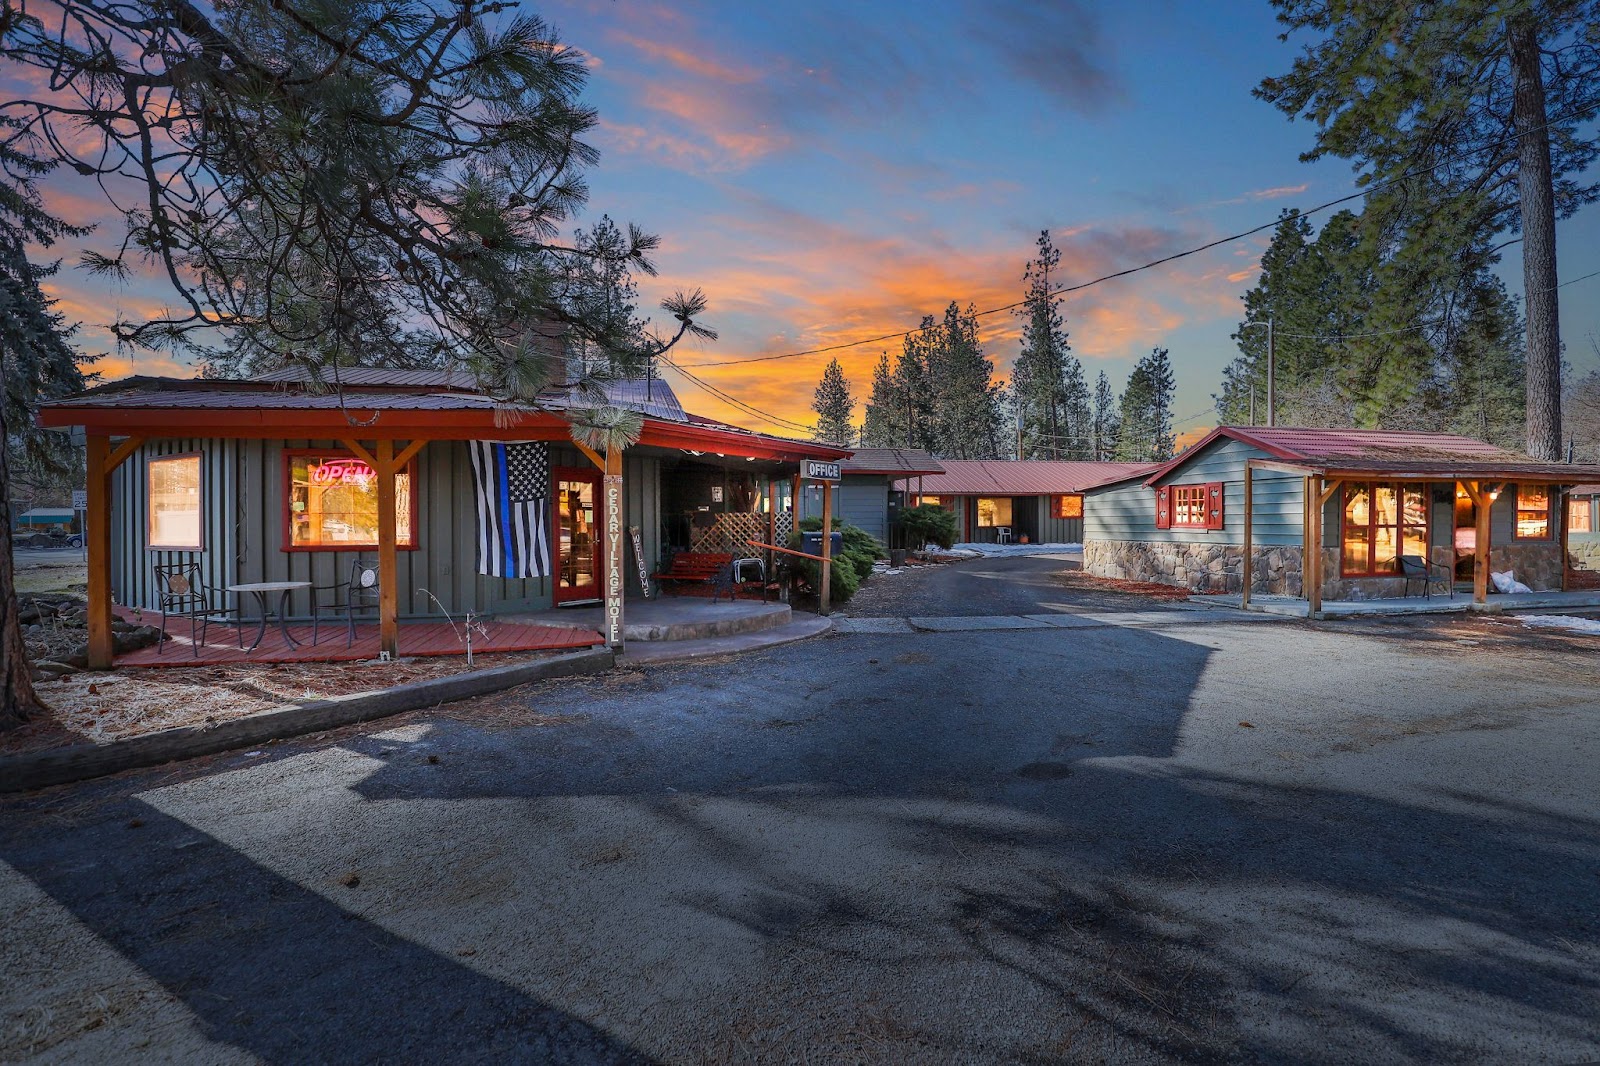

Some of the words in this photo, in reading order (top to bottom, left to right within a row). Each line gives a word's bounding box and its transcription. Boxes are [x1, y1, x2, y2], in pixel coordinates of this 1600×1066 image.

[313, 465, 370, 483] OPEN
[809, 462, 838, 477] OFFICE
[632, 534, 650, 598] WELCOME
[608, 598, 620, 642] MOTEL
